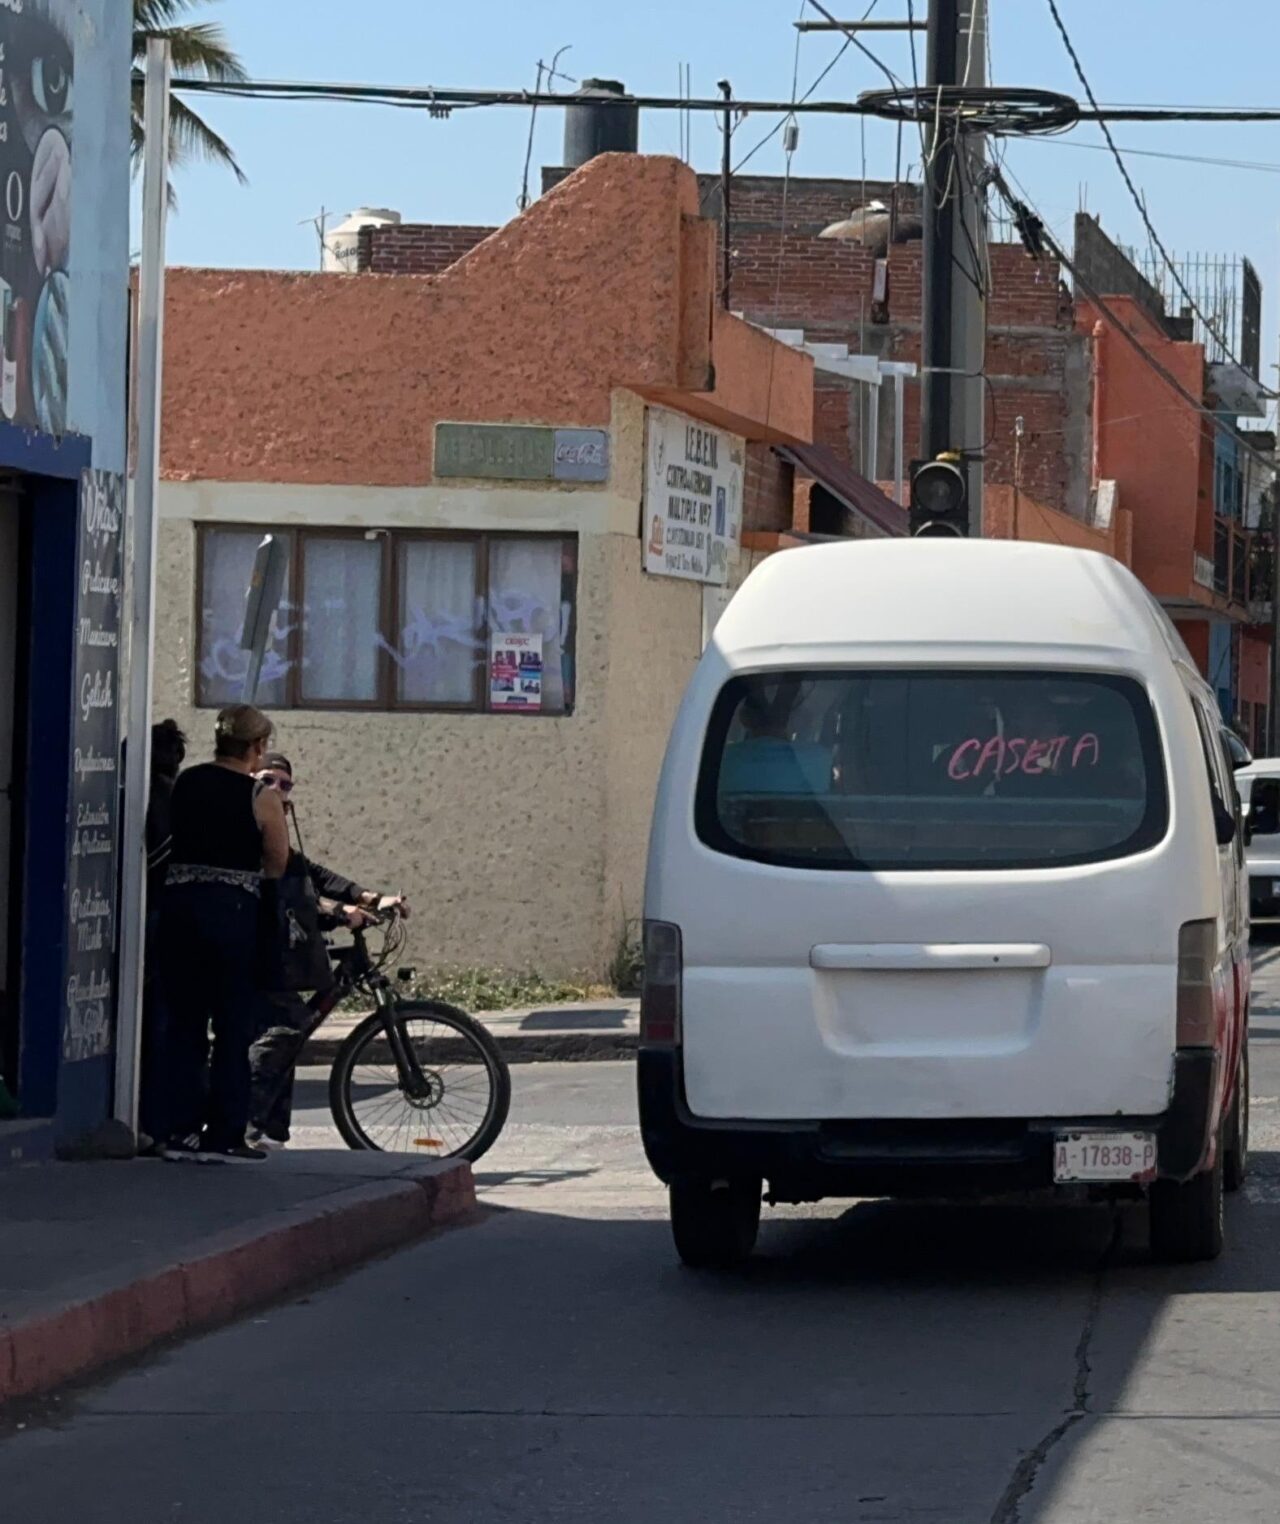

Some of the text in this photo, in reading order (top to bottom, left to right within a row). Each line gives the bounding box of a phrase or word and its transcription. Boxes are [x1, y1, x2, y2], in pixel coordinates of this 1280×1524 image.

[555, 442, 605, 466] Coca-Cola
[667, 495, 697, 524] MULTIPLE
[82, 559, 119, 596] Pedicure
[948, 731, 1100, 781] CASETA
[1056, 1145, 1155, 1168] A-17838-P
